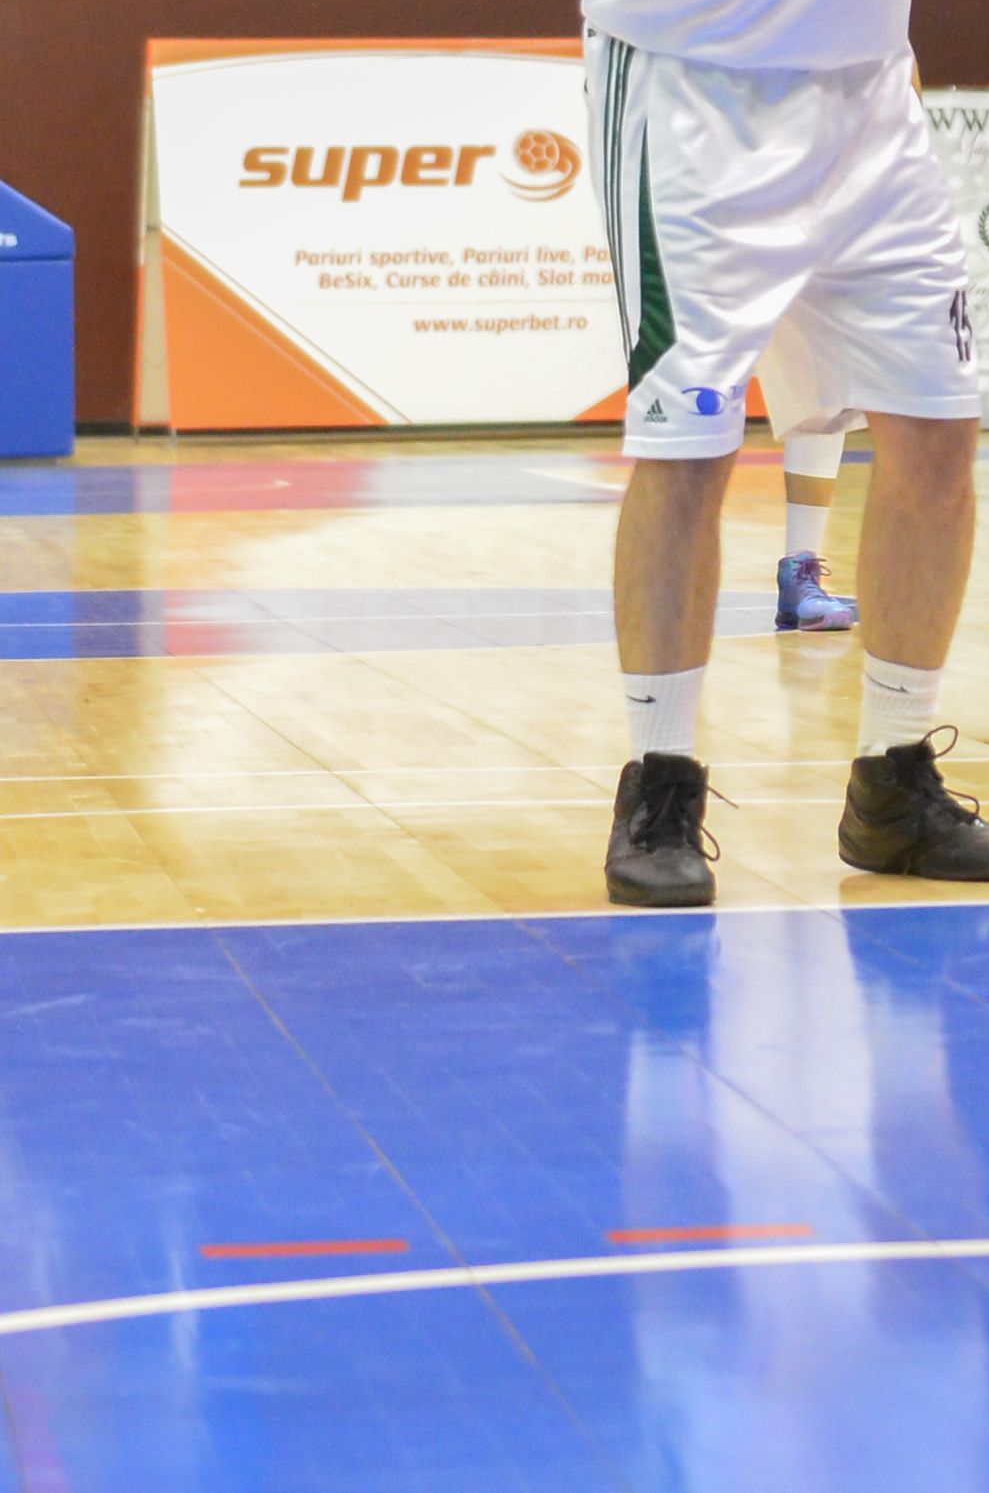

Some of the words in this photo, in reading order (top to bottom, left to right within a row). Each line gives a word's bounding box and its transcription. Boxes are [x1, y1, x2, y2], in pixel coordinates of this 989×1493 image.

[239, 144, 497, 202] super
[295, 249, 363, 267] Pariuri
[370, 249, 455, 269] sportive,
[463, 247, 530, 265] Pariuri
[537, 245, 576, 265] live,
[318, 272, 378, 291] BeSix,
[386, 271, 441, 289] Curse
[448, 270, 471, 288] de
[538, 269, 575, 287] Slot
[413, 313, 588, 334] www.superbet.ro
